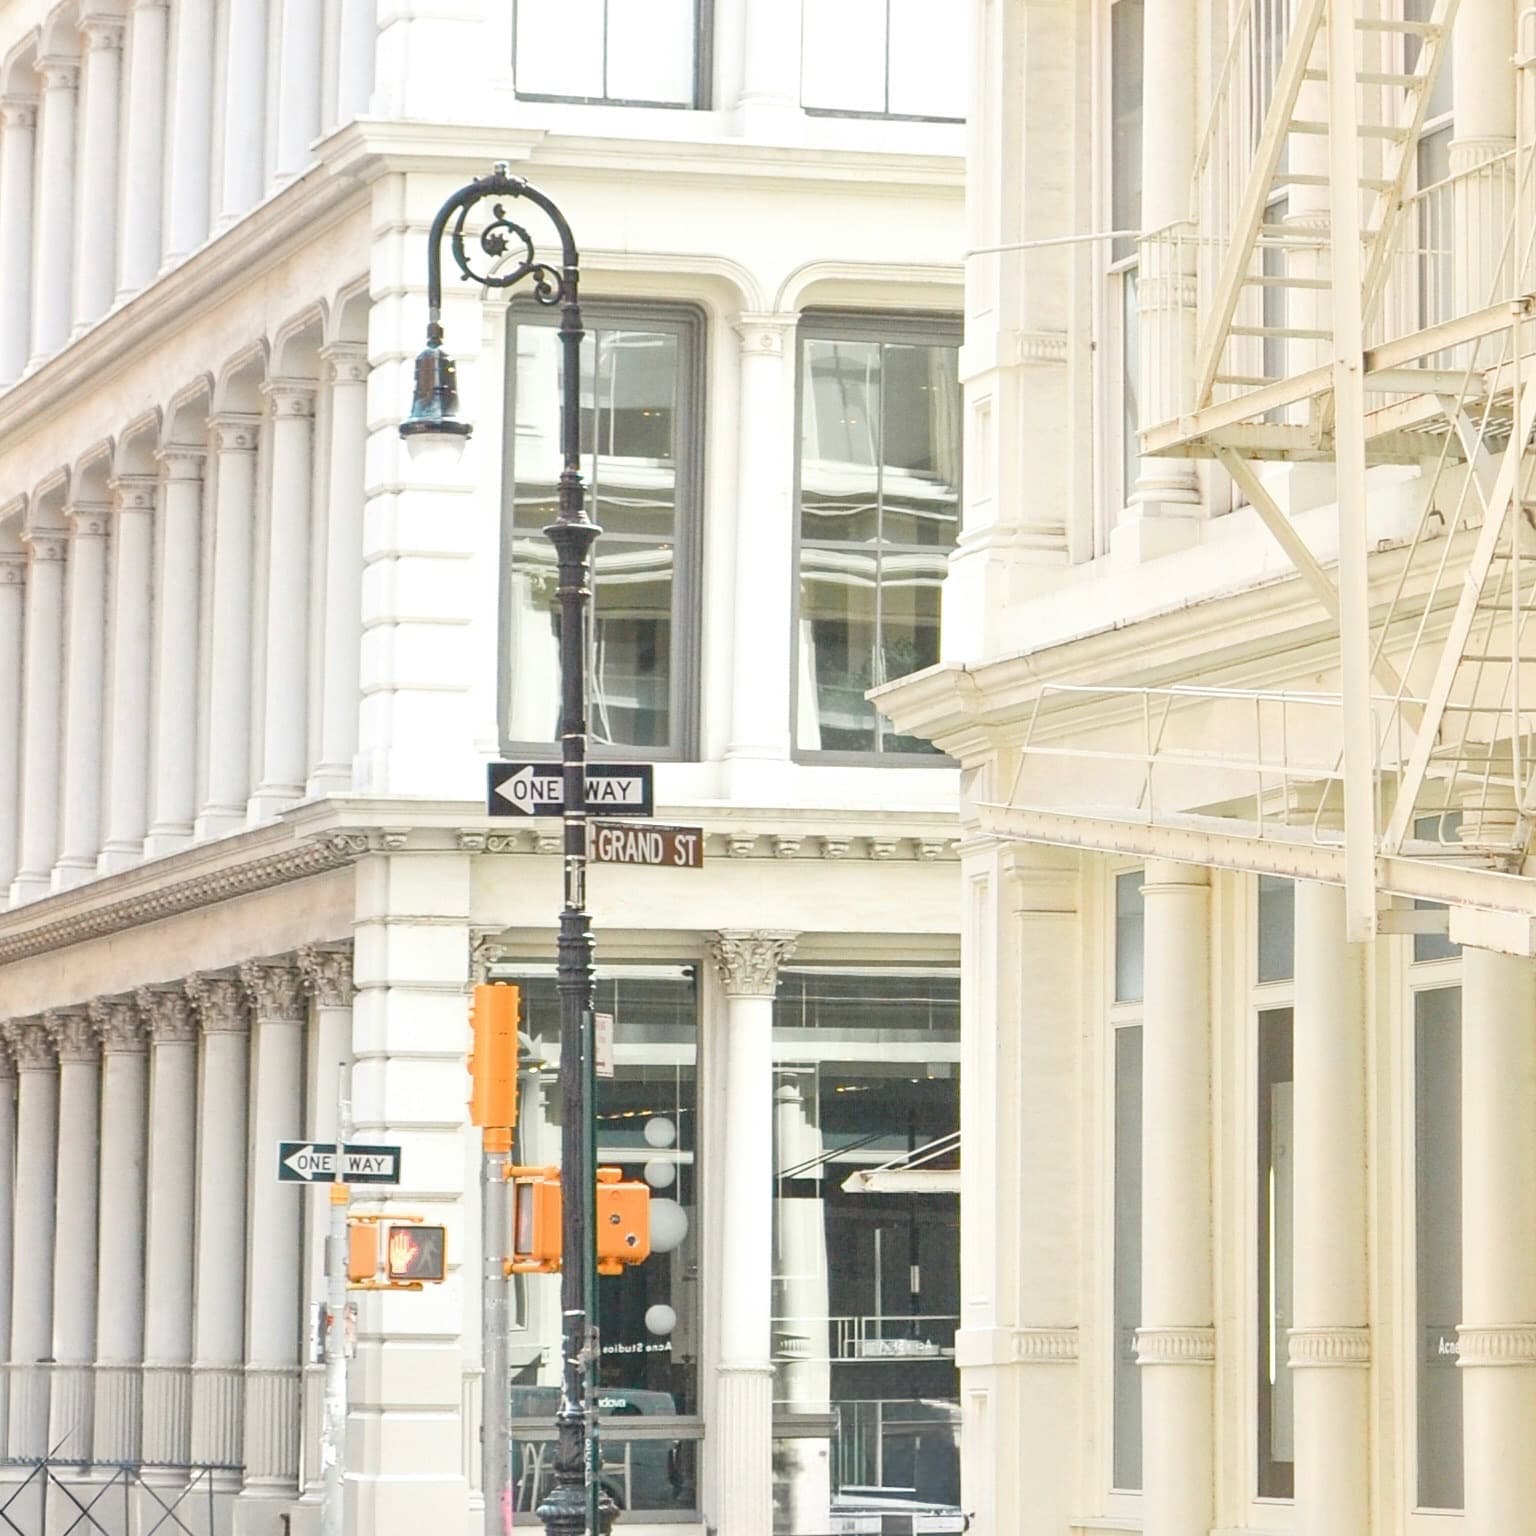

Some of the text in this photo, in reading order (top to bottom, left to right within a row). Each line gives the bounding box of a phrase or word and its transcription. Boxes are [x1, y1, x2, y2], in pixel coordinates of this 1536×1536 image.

[513, 780, 632, 801] ONE WAY
[598, 829, 664, 864] GRAND
[673, 834, 697, 866] ST
[297, 1155, 385, 1172] ONE WAY
